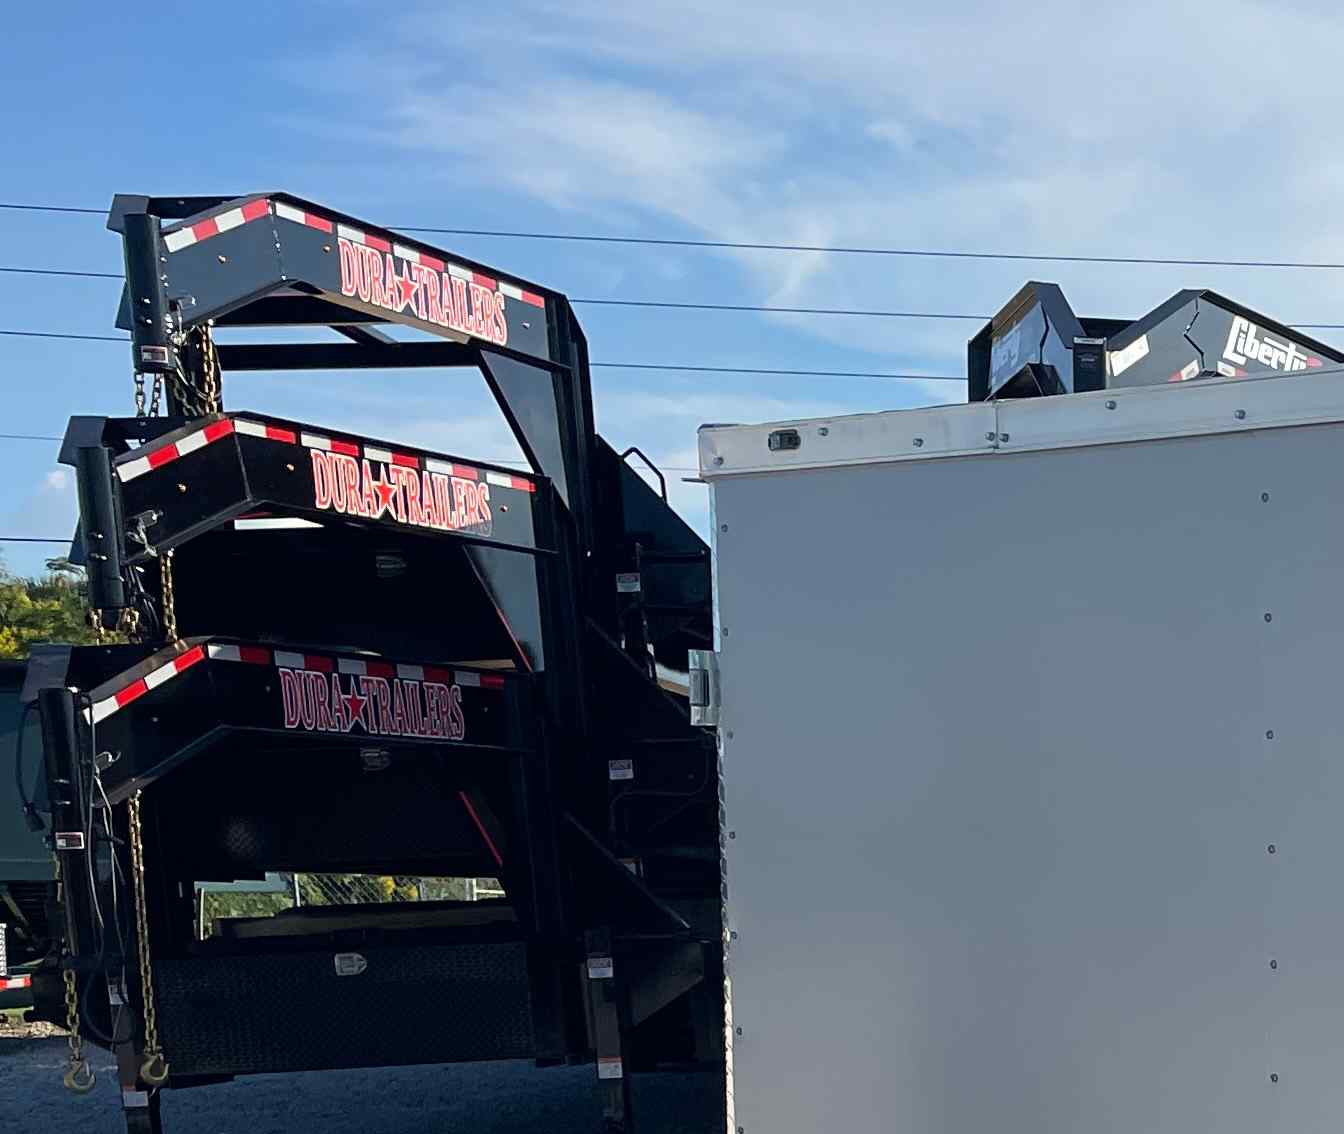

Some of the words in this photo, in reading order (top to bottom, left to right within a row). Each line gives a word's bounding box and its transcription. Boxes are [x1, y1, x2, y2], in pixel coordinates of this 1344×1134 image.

[338, 238, 402, 313] DURA
[411, 261, 508, 347] TRAILERS
[310, 449, 381, 519] DURA
[388, 464, 493, 537] TRAILERS
[279, 667, 350, 733] DURA
[359, 676, 465, 740] TRAILERS
